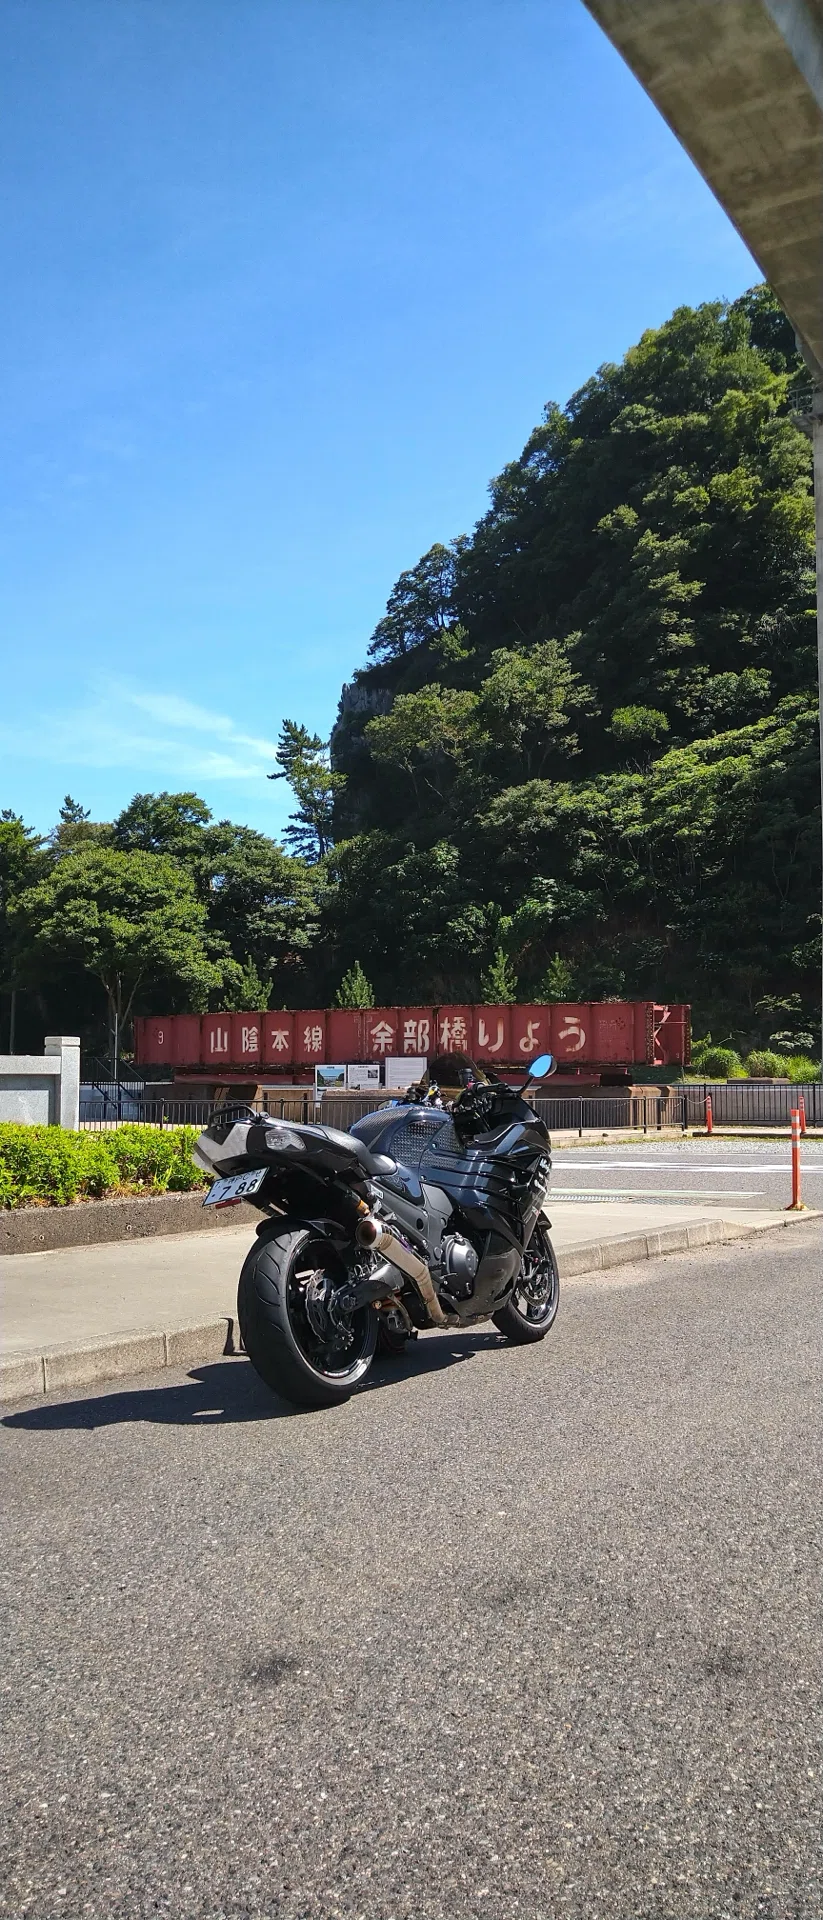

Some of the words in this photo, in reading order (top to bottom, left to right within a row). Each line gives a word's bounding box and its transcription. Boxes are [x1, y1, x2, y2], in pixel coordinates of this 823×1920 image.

[210, 1025, 323, 1053] 山陰本線
[370, 1016, 586, 1053] 余部橋りょう
